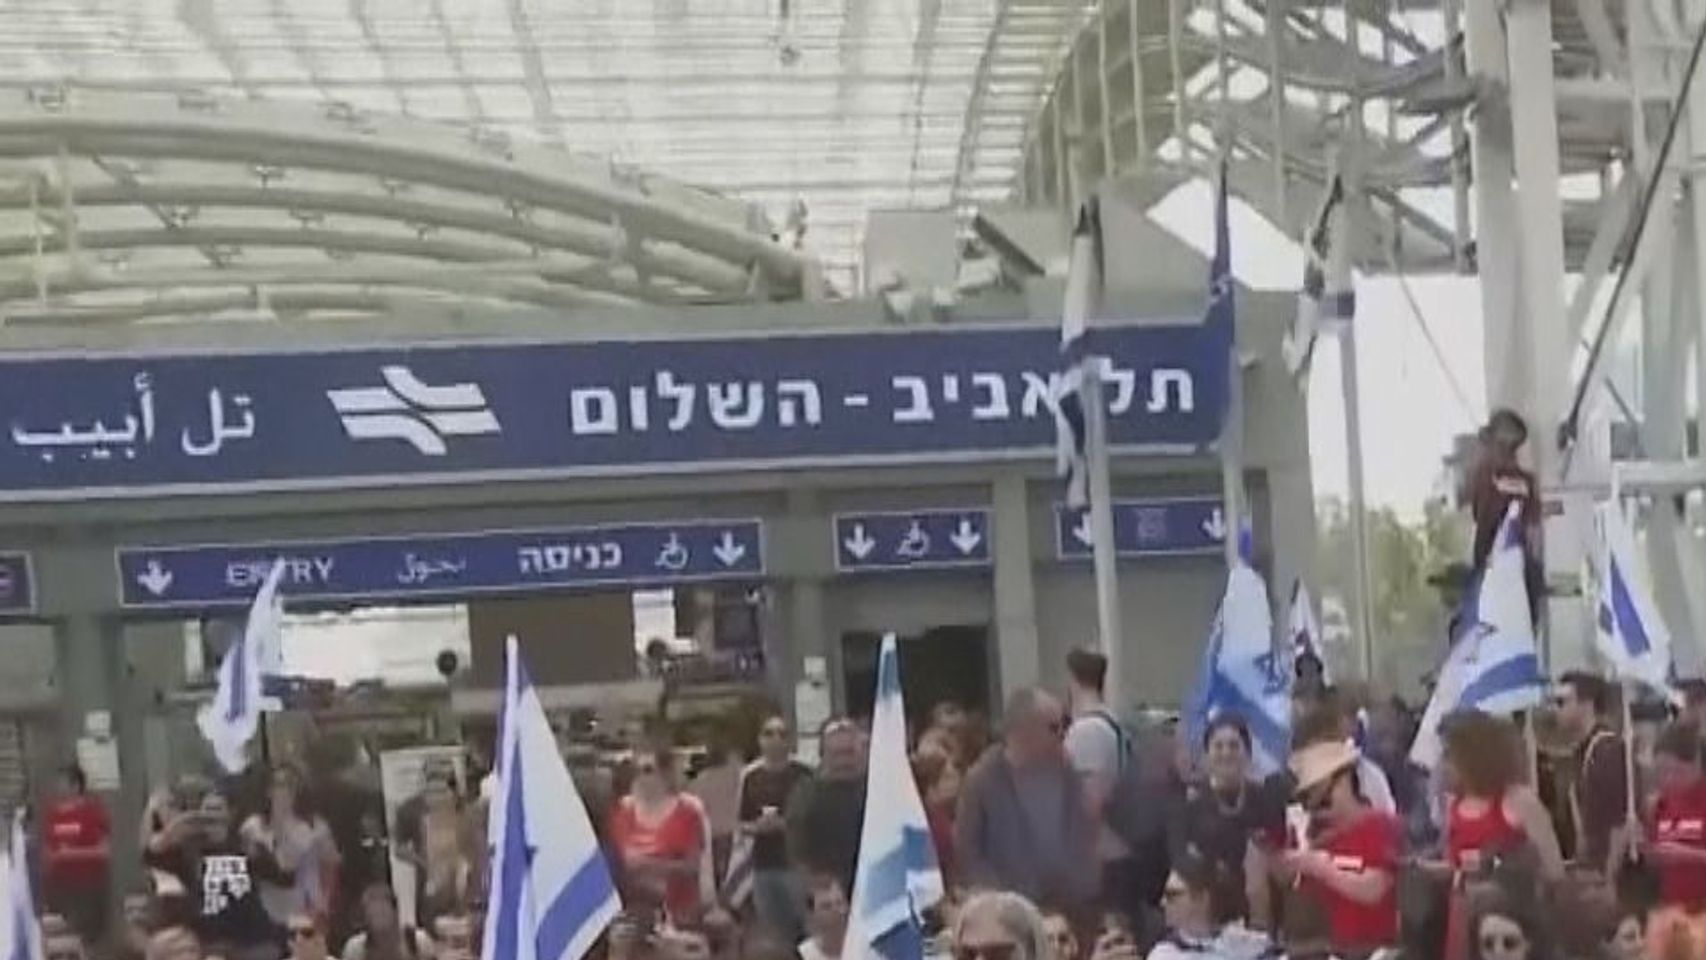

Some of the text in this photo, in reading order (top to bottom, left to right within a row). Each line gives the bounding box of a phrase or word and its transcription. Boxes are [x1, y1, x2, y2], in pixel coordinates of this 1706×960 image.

[571, 370, 821, 434] השלום
[893, 371, 1062, 422] אביב
[1096, 356, 1194, 415] תל
[12, 371, 255, 461] تل أبيب
[226, 557, 333, 586] ENRY
[518, 542, 622, 574] כניסה
